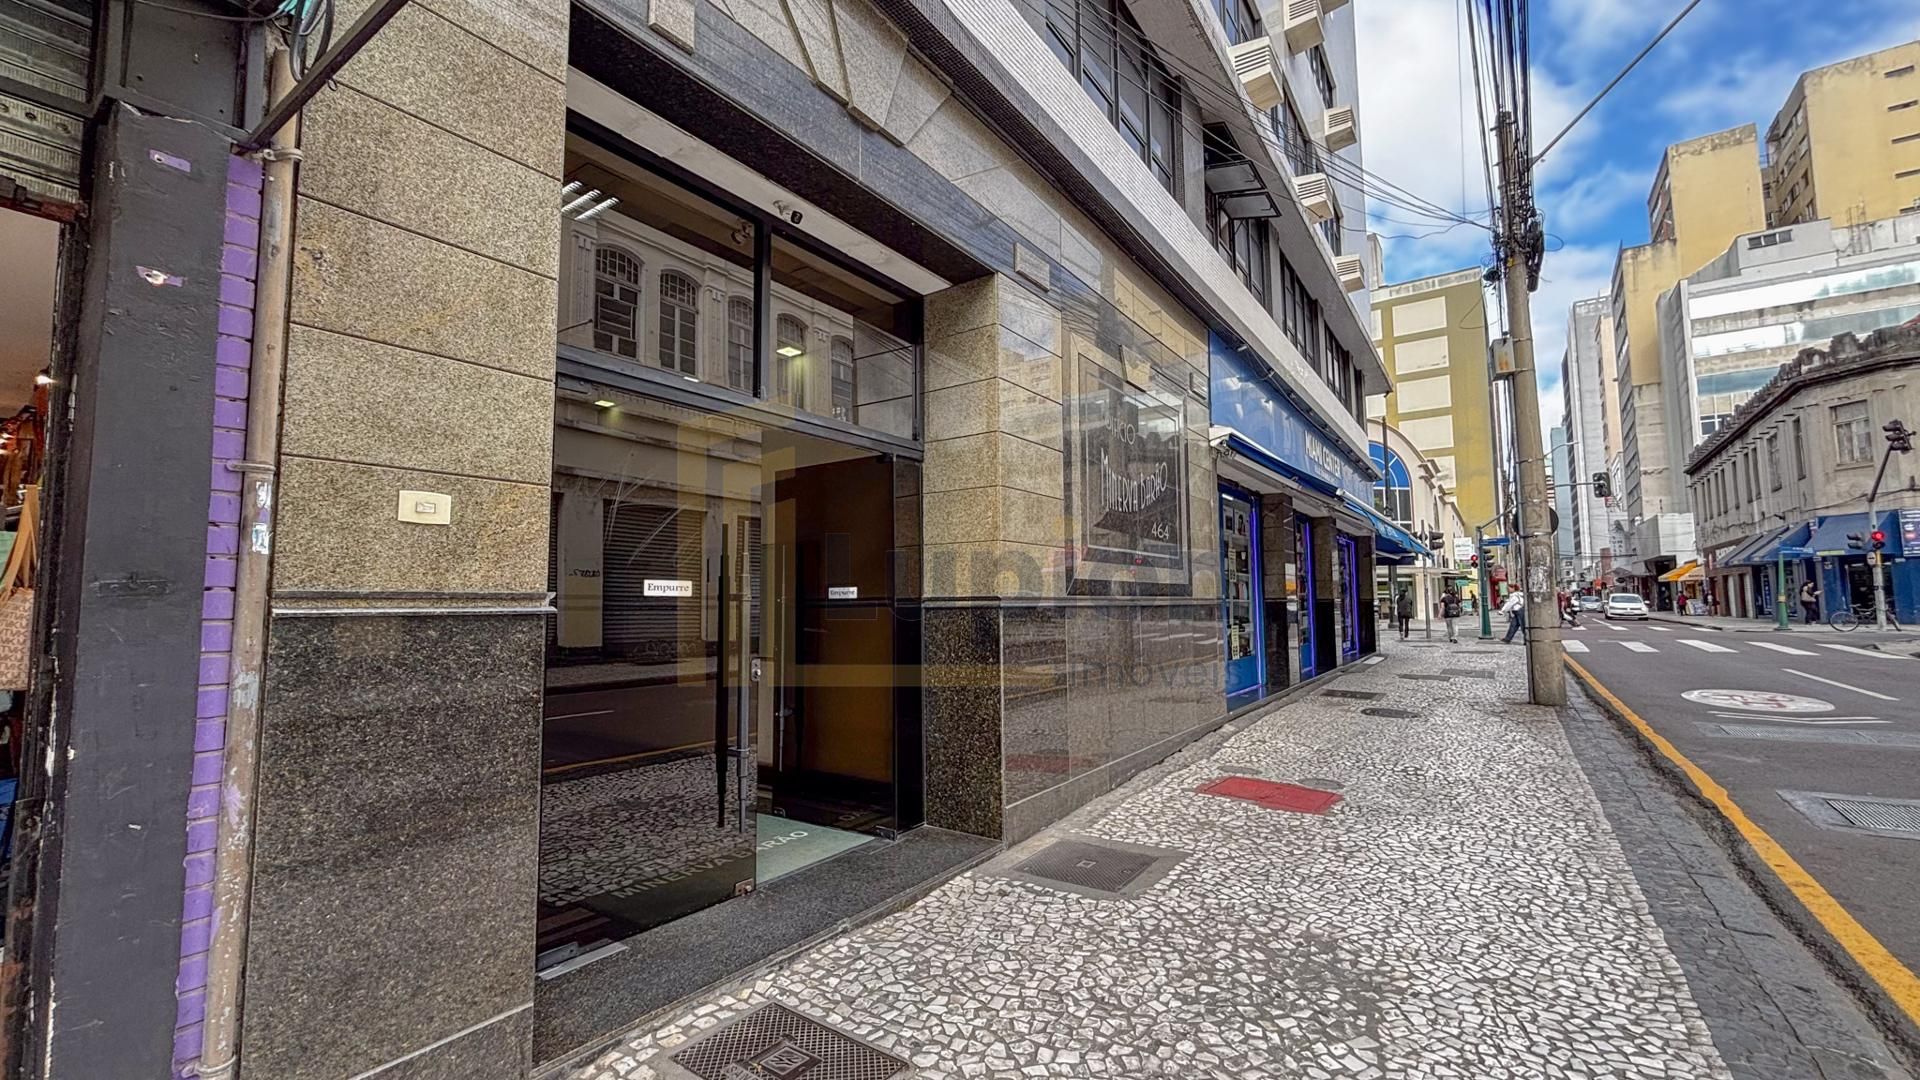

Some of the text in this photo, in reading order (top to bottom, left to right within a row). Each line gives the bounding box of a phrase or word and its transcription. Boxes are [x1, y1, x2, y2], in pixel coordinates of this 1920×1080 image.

[1151, 521, 1169, 540] 464
[647, 582, 690, 595] Empurre
[610, 856, 733, 899] MINERVA
